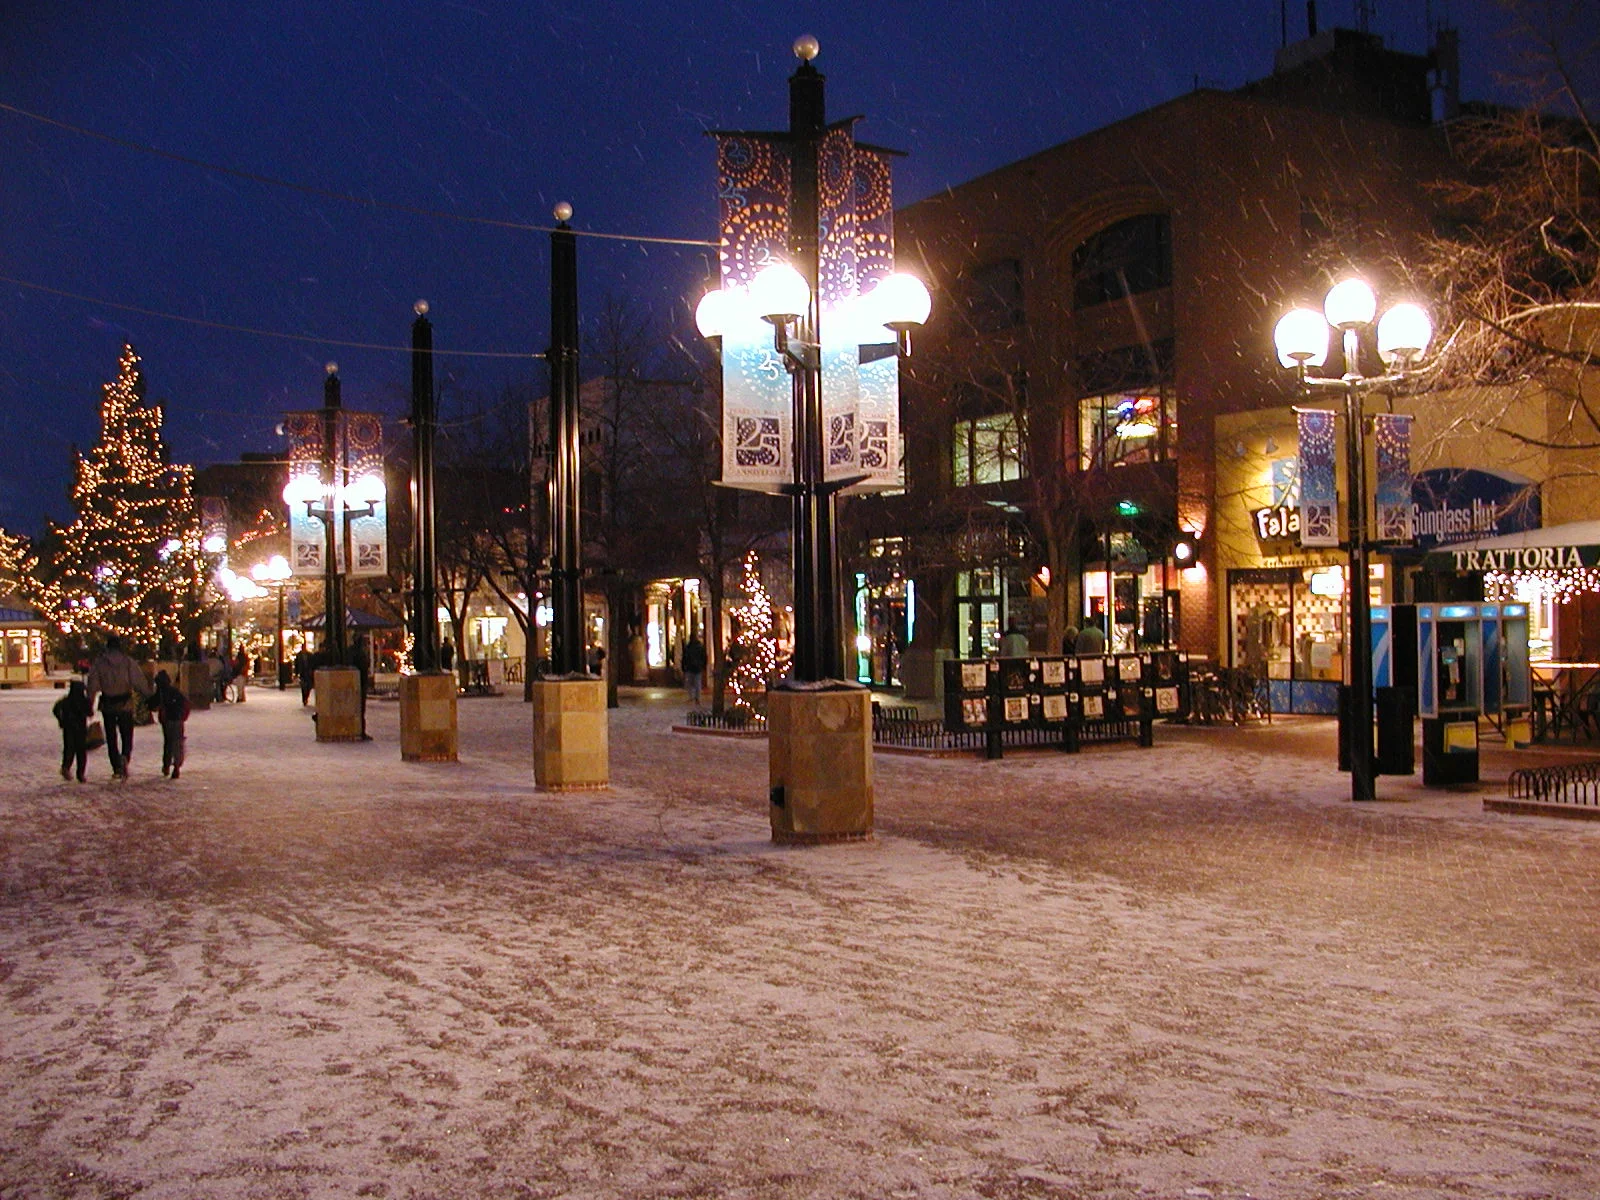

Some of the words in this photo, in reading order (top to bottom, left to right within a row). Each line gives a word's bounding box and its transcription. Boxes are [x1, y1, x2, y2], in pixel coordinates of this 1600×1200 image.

[736, 416, 782, 466] 25
[830, 414, 855, 464] 25
[1257, 507, 1300, 539] Fala
[1308, 504, 1331, 537] 25
[1411, 500, 1471, 543] Sunglass
[1473, 497, 1498, 531] Hut
[298, 543, 320, 567] 25
[359, 543, 381, 567] 25
[1452, 547, 1584, 571] TRATTORIA
